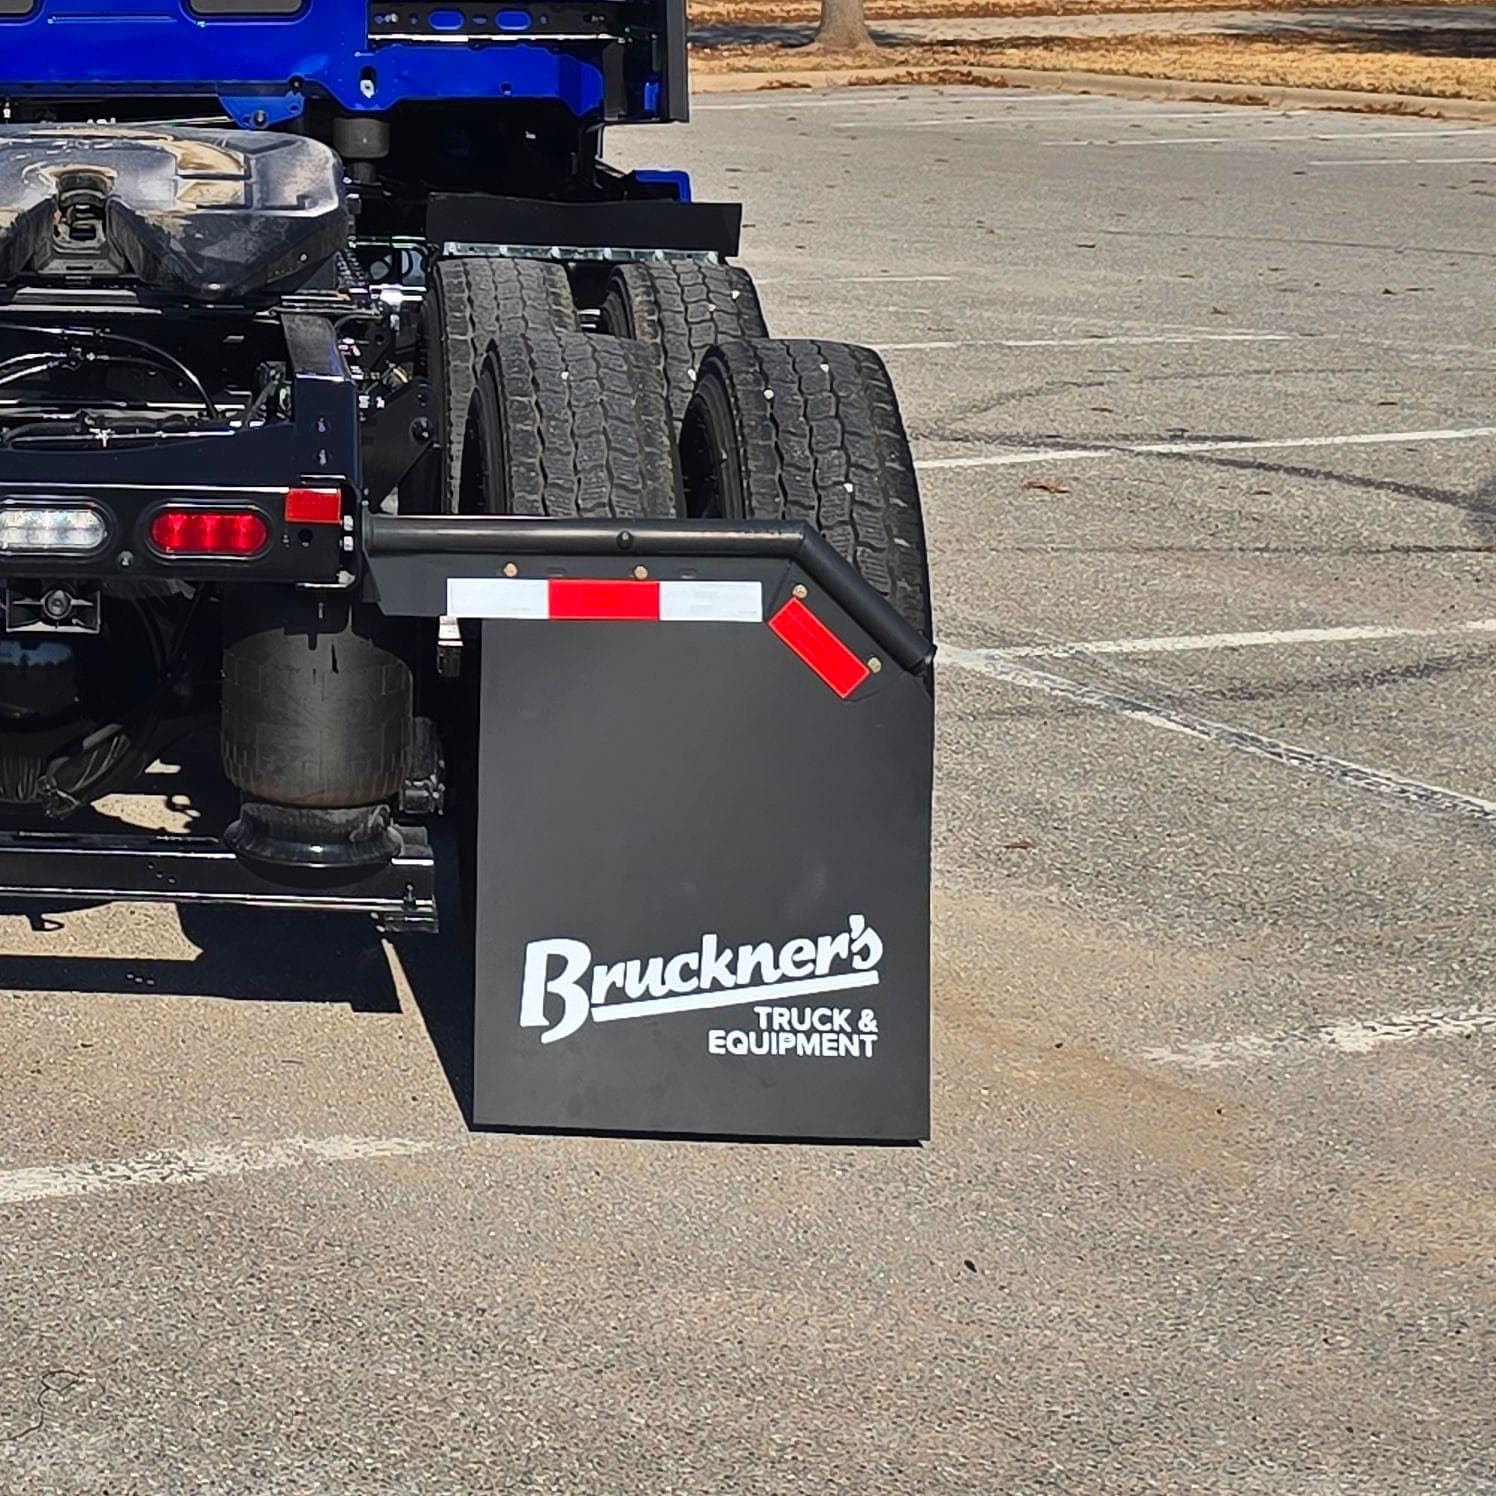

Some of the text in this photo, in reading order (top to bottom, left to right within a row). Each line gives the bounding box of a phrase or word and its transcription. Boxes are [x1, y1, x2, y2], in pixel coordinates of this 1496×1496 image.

[519, 914, 884, 1045] Bruckner's
[753, 1006, 879, 1033] TRUCK &
[708, 1029, 878, 1058] EQUIPMENT
